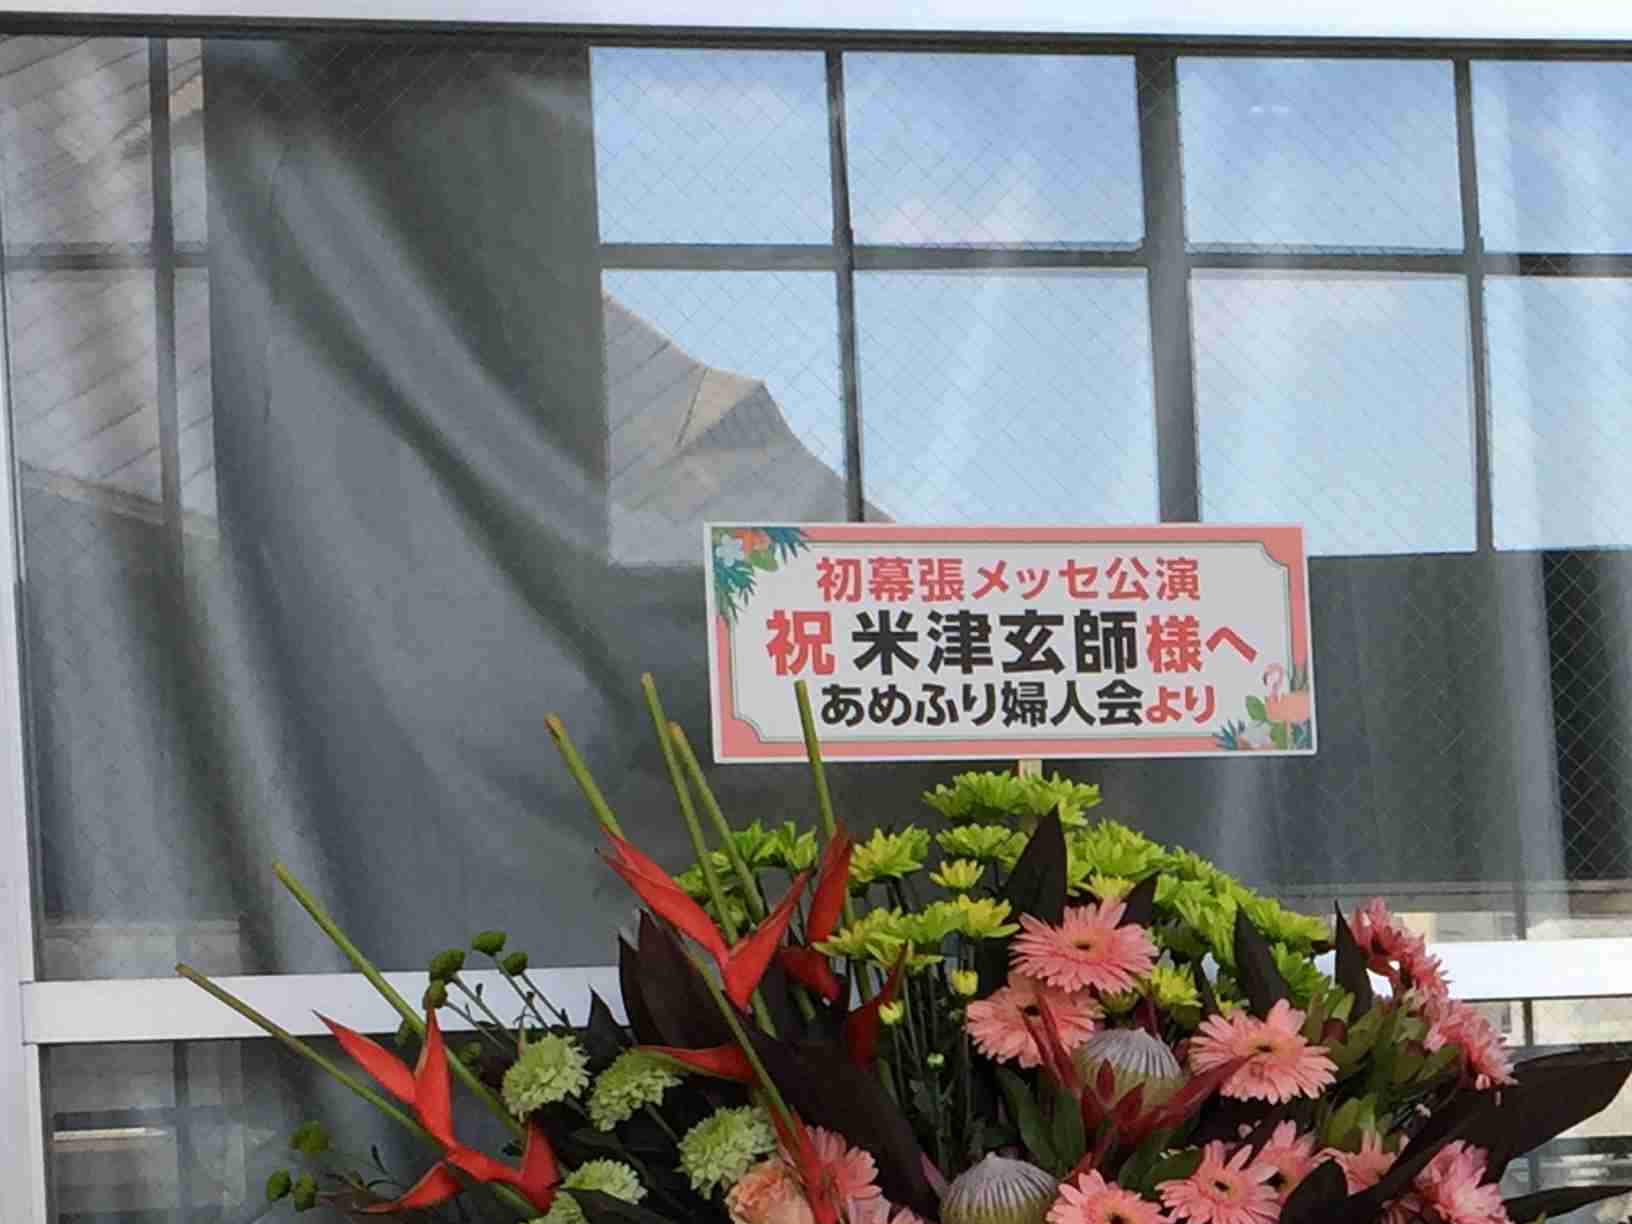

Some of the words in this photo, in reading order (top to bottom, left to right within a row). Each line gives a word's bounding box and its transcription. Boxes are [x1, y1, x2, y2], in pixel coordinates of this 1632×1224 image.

[816, 556, 1200, 602] 初幕張メッセ公演
[821, 678, 1217, 728] あめふり婦人会より
